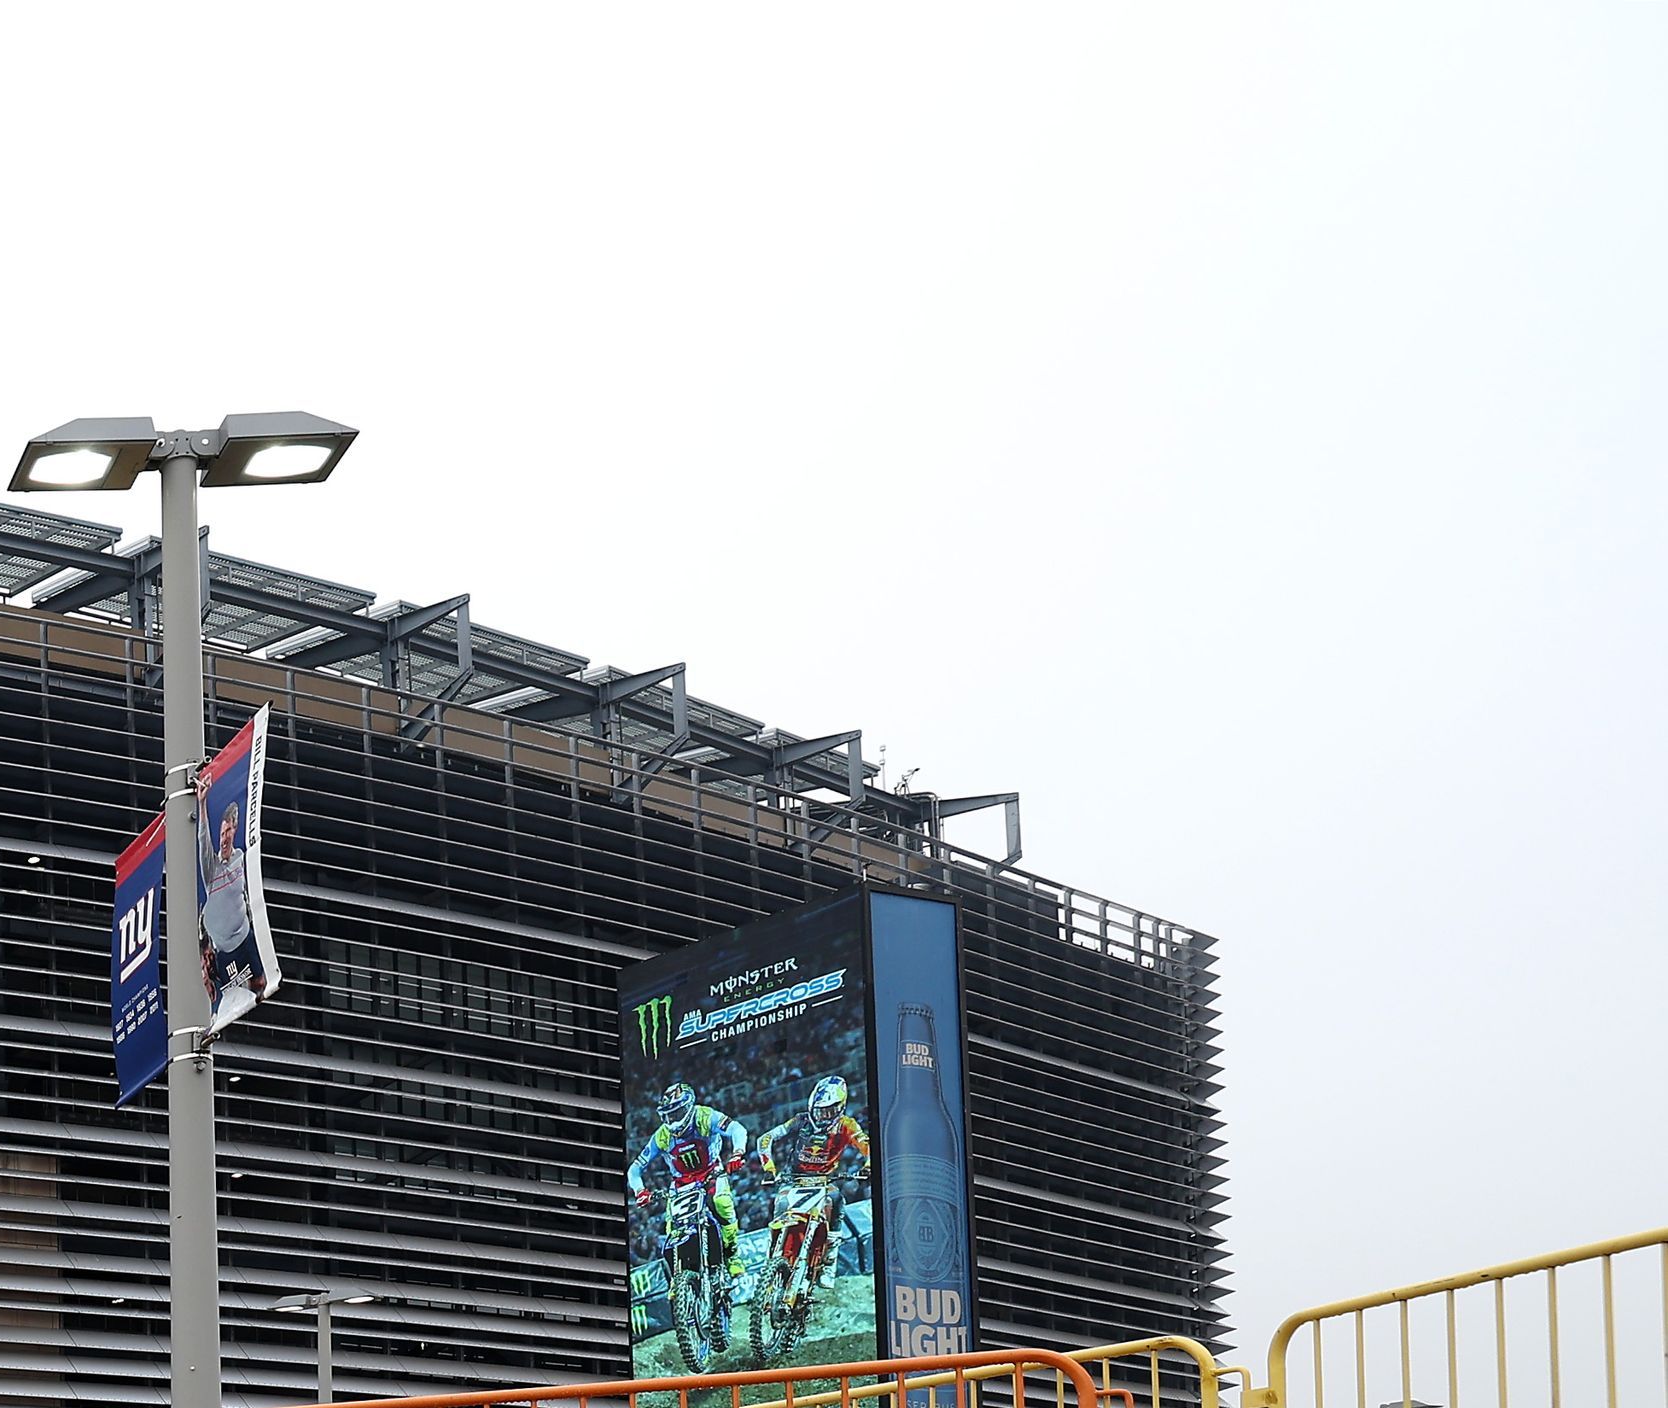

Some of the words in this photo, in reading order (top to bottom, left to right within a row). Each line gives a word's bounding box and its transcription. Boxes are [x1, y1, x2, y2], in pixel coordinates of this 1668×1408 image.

[249, 771, 259, 847] PARCELLS
[676, 968, 848, 1041] SUPERCROSS
[723, 977, 786, 1003] ENERGY
[683, 1009, 702, 1021] AMA
[711, 1003, 807, 1042] CHAMPIONSHIP
[902, 1054, 934, 1069] LIGHT
[905, 1043, 929, 1056] BUD
[895, 1285, 961, 1325] BUD
[891, 1320, 968, 1358] LIGHT
